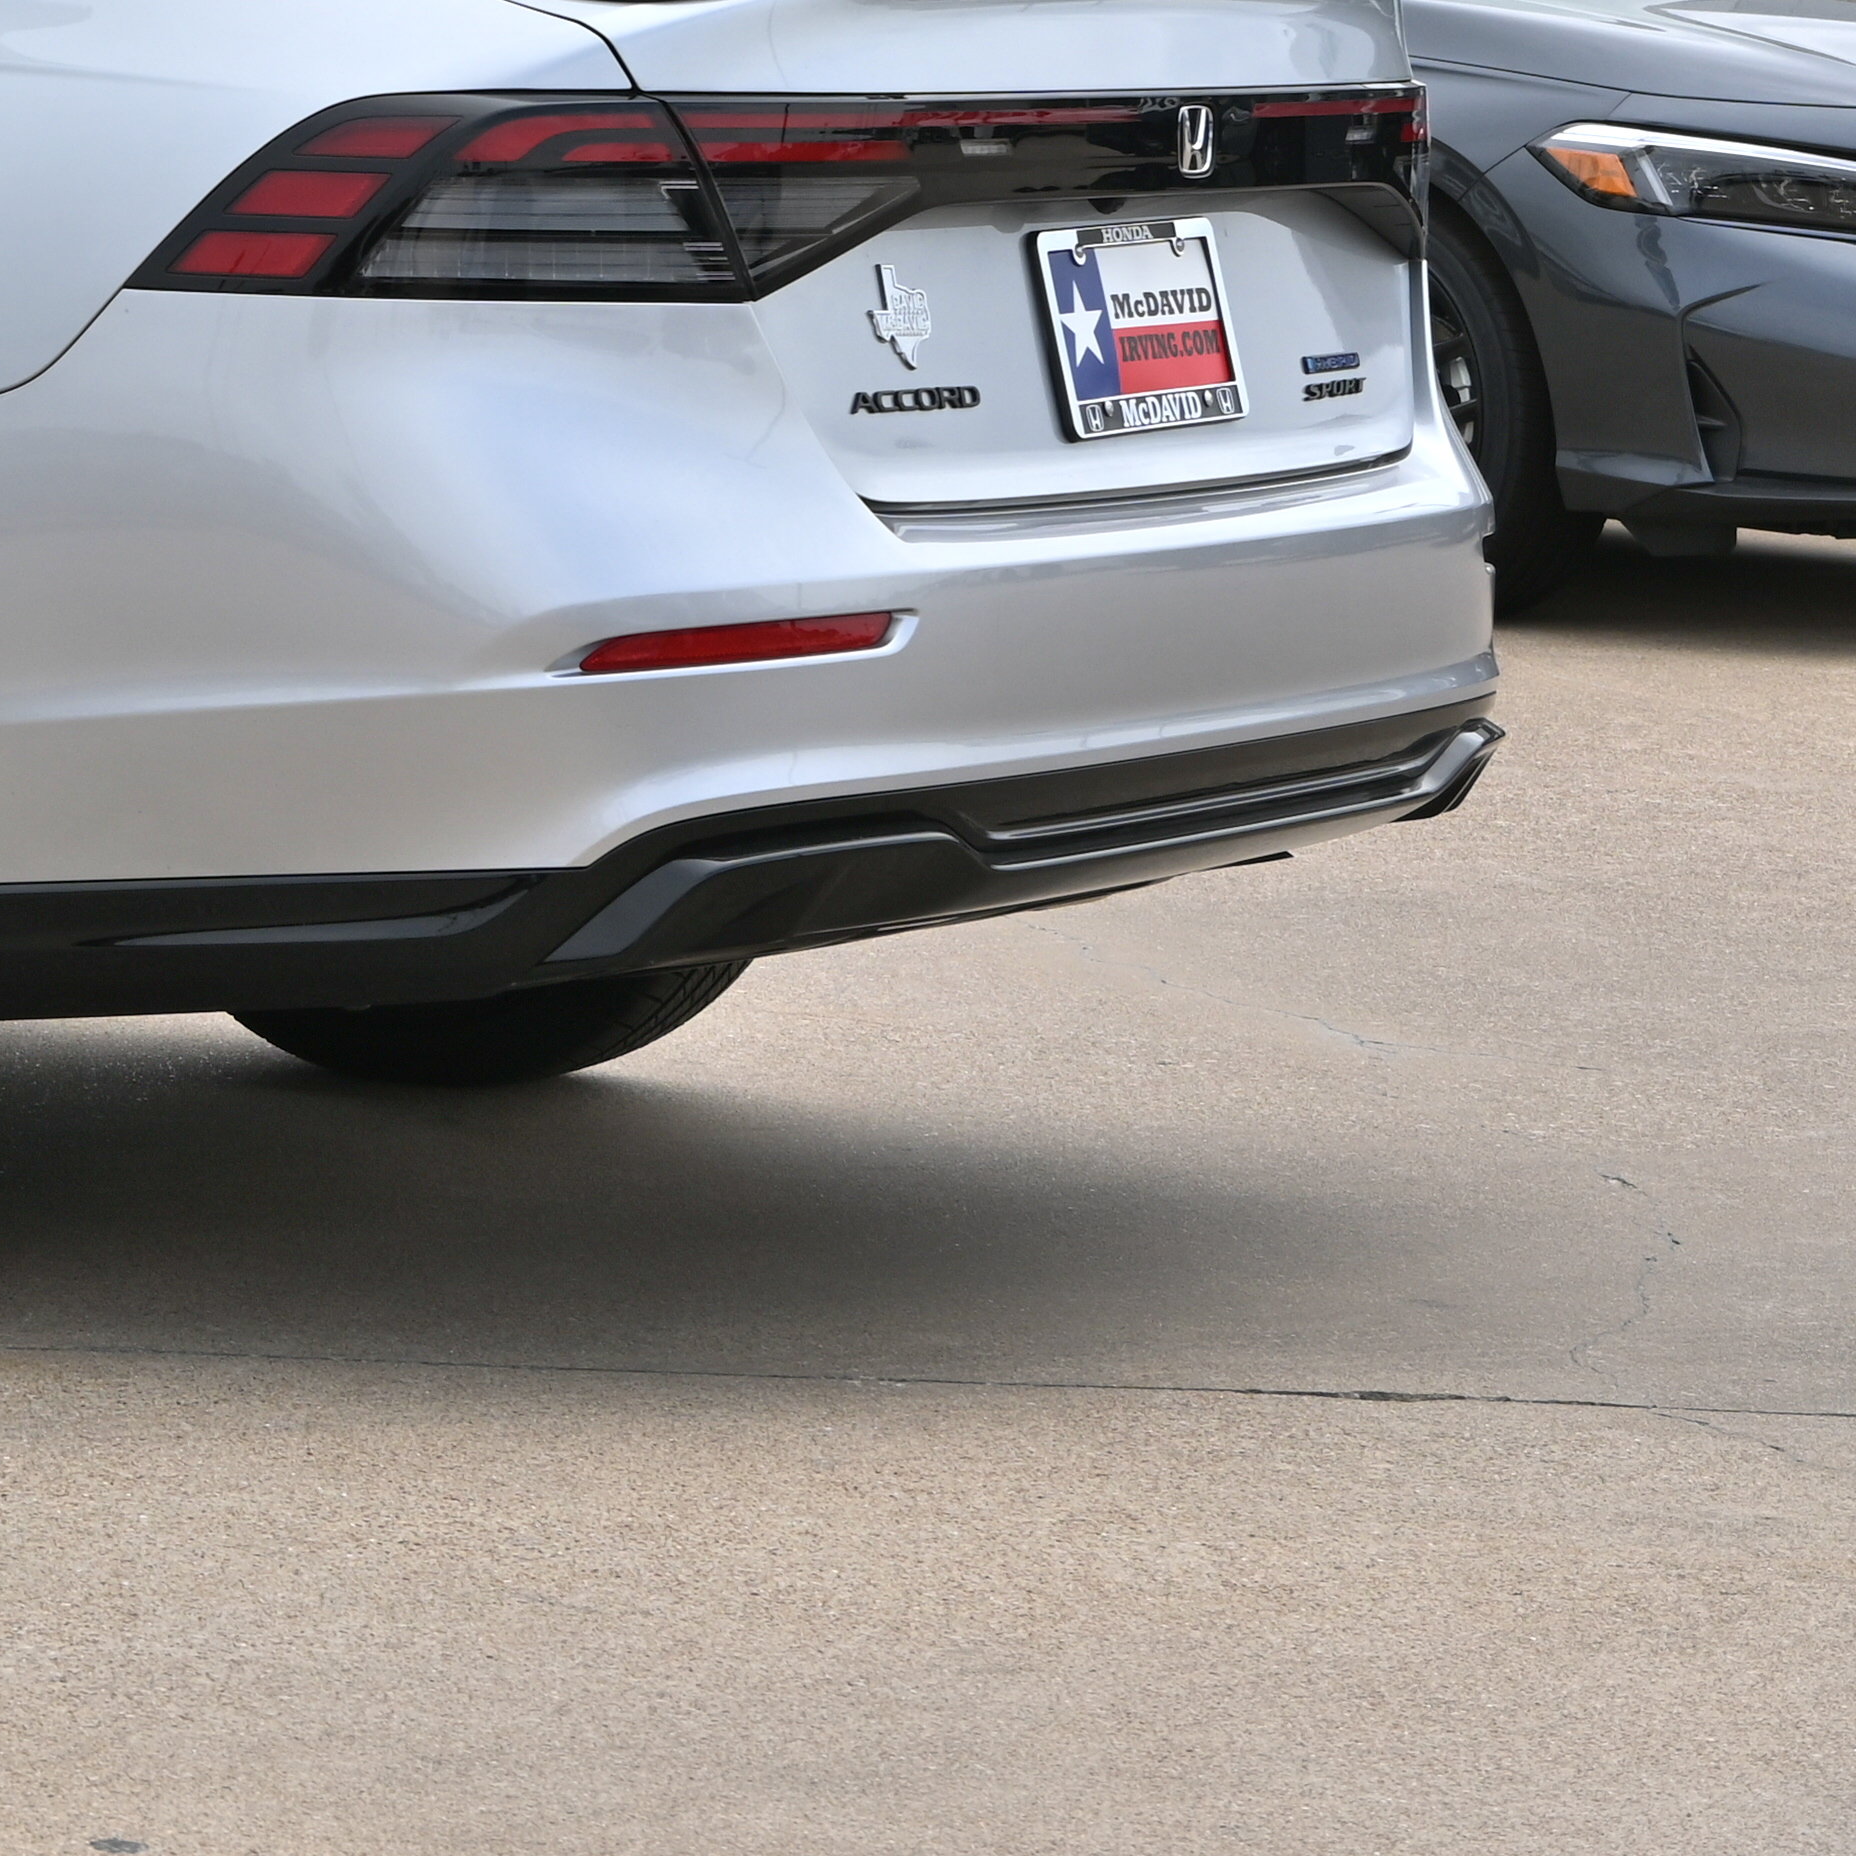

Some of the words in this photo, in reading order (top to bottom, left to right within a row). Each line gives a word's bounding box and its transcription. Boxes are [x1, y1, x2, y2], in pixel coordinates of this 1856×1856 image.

[1101, 224, 1154, 243] HONDA
[1111, 287, 1213, 320] McDAVID
[1119, 329, 1220, 362] IRVING.COM
[849, 385, 981, 415] ACCORD
[1302, 377, 1367, 401] SPORT
[1120, 391, 1203, 428] McDAVID
